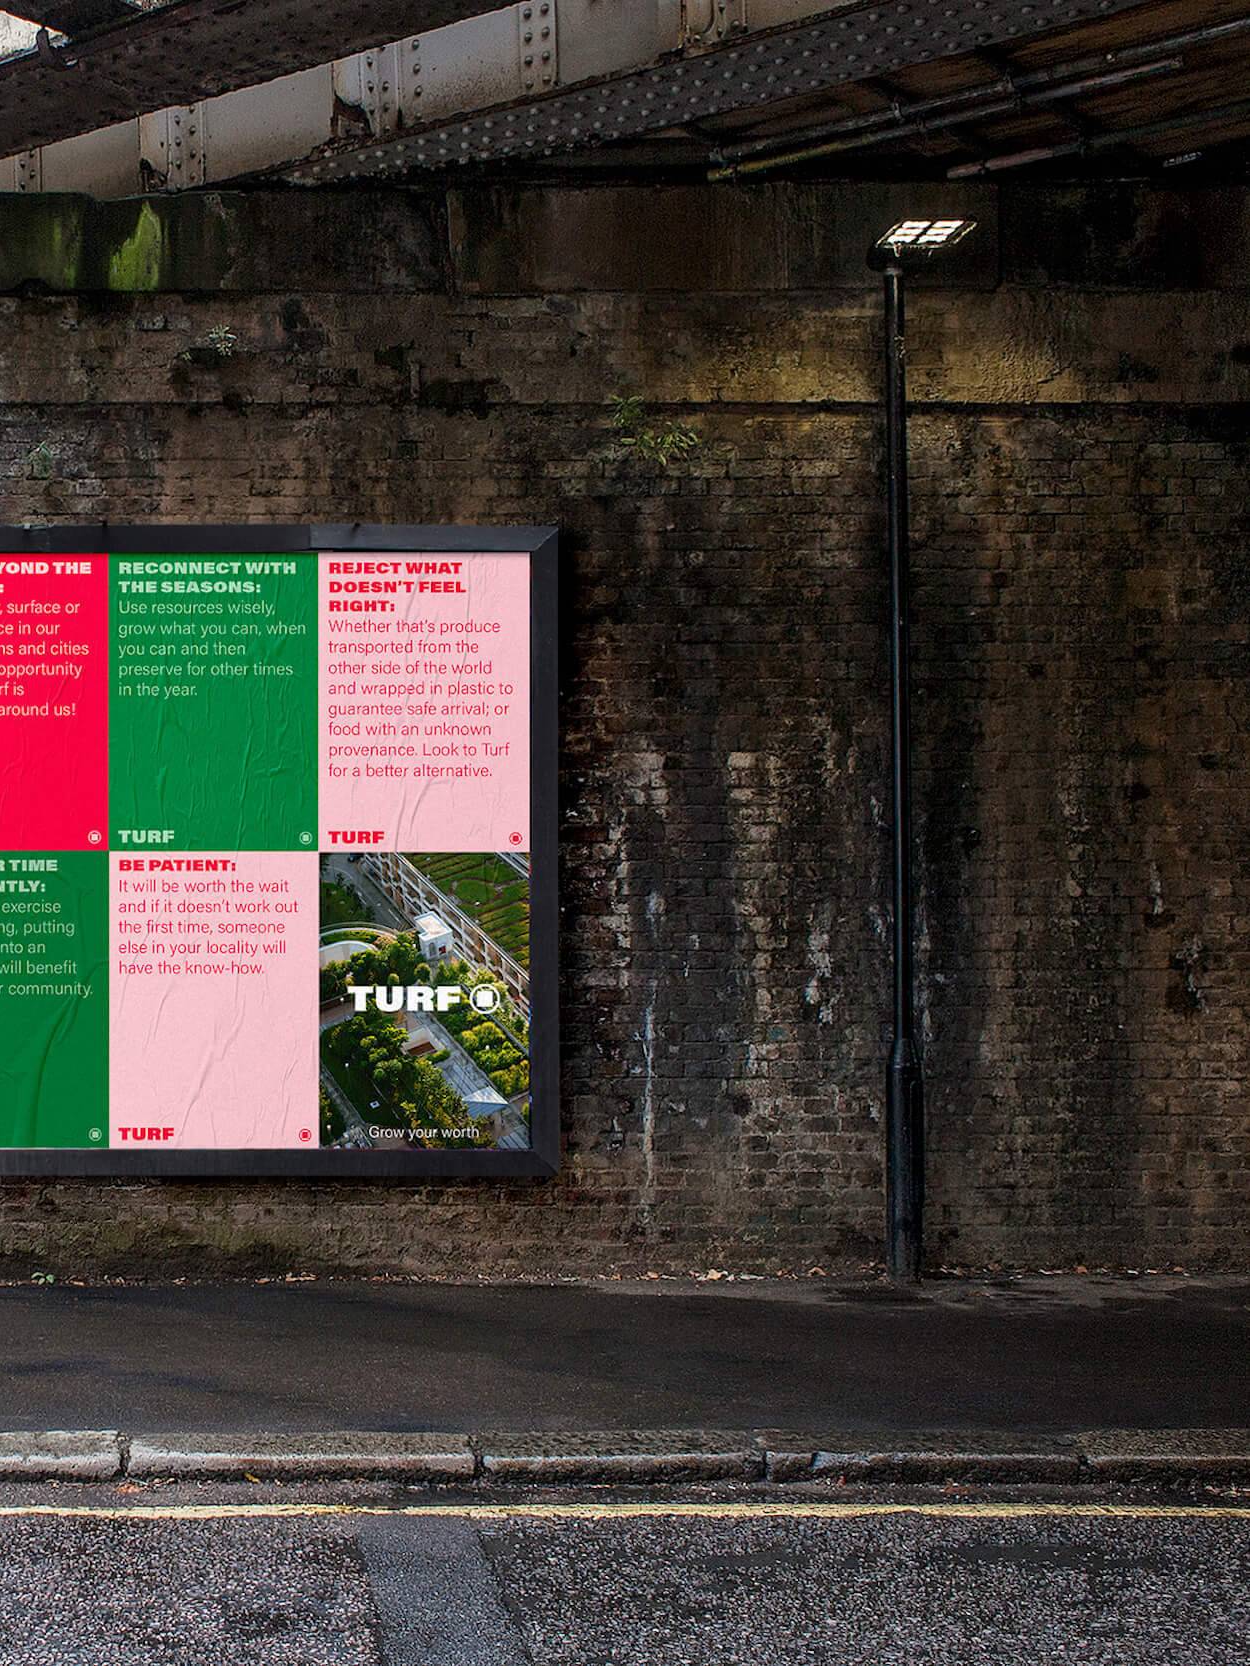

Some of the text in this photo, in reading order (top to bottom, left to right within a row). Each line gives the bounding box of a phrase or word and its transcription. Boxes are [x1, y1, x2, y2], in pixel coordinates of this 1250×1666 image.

[53, 562, 91, 574] THE
[119, 562, 296, 574] RECONNECT WITH
[329, 562, 462, 574] REJECT WHAT
[118, 581, 260, 593] THE SEASONS:
[329, 580, 466, 593] DOESN'T FEEL
[7, 600, 61, 614] surface
[65, 603, 80, 614] or
[119, 600, 275, 617] Use resources wisely,
[329, 600, 394, 612] RIGHT:
[19, 620, 31, 634] in
[36, 624, 60, 635] our
[119, 621, 305, 638] grow what you can, when
[329, 619, 500, 636] Whether that's produce
[19, 641, 45, 656] and
[51, 640, 89, 655] cities
[119, 642, 245, 658] you can and then
[328, 640, 478, 656] transported from the
[329, 660, 492, 674] other side of the world
[118, 830, 174, 843] TURF
[328, 831, 384, 844] TURF
[9, 860, 58, 871] TIME
[119, 860, 236, 871] BE PATIENT:
[120, 880, 288, 892] It will be worth the wait
[2, 903, 61, 913] exercise
[119, 899, 298, 913] and if it doesn't work out
[24, 920, 74, 936] putting
[28, 944, 45, 953] an
[347, 985, 461, 1013] TURF
[118, 1128, 174, 1141] TURF
[368, 1126, 480, 1142] Grow your worth
